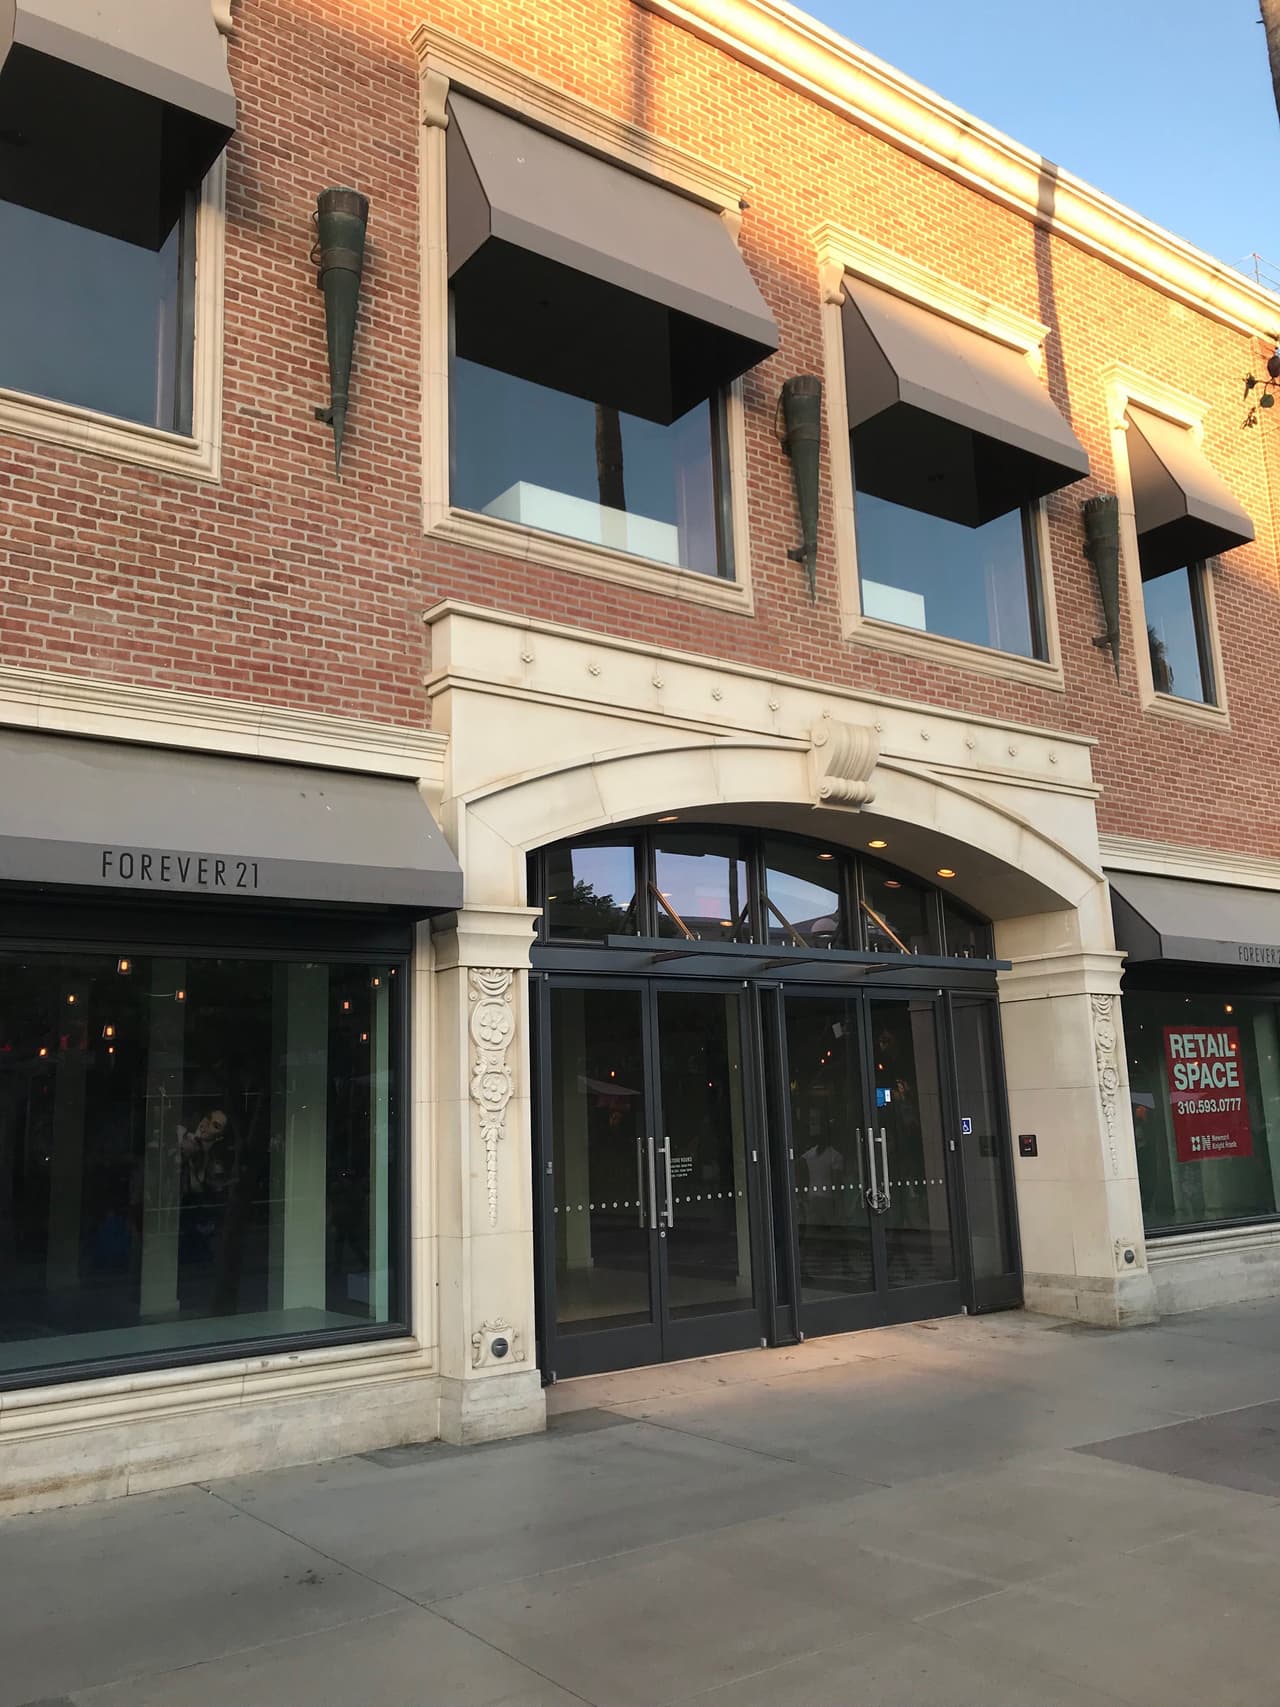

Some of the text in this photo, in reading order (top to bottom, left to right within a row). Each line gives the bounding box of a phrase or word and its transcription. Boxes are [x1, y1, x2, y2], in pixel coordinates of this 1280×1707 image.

[102, 851, 259, 888] FOREVER 21
[1238, 945, 1277, 963] FOREVER
[1169, 1033, 1236, 1058] RETAIL
[1173, 1062, 1240, 1090] SPACE
[1178, 1097, 1241, 1115] 310.593.0777
